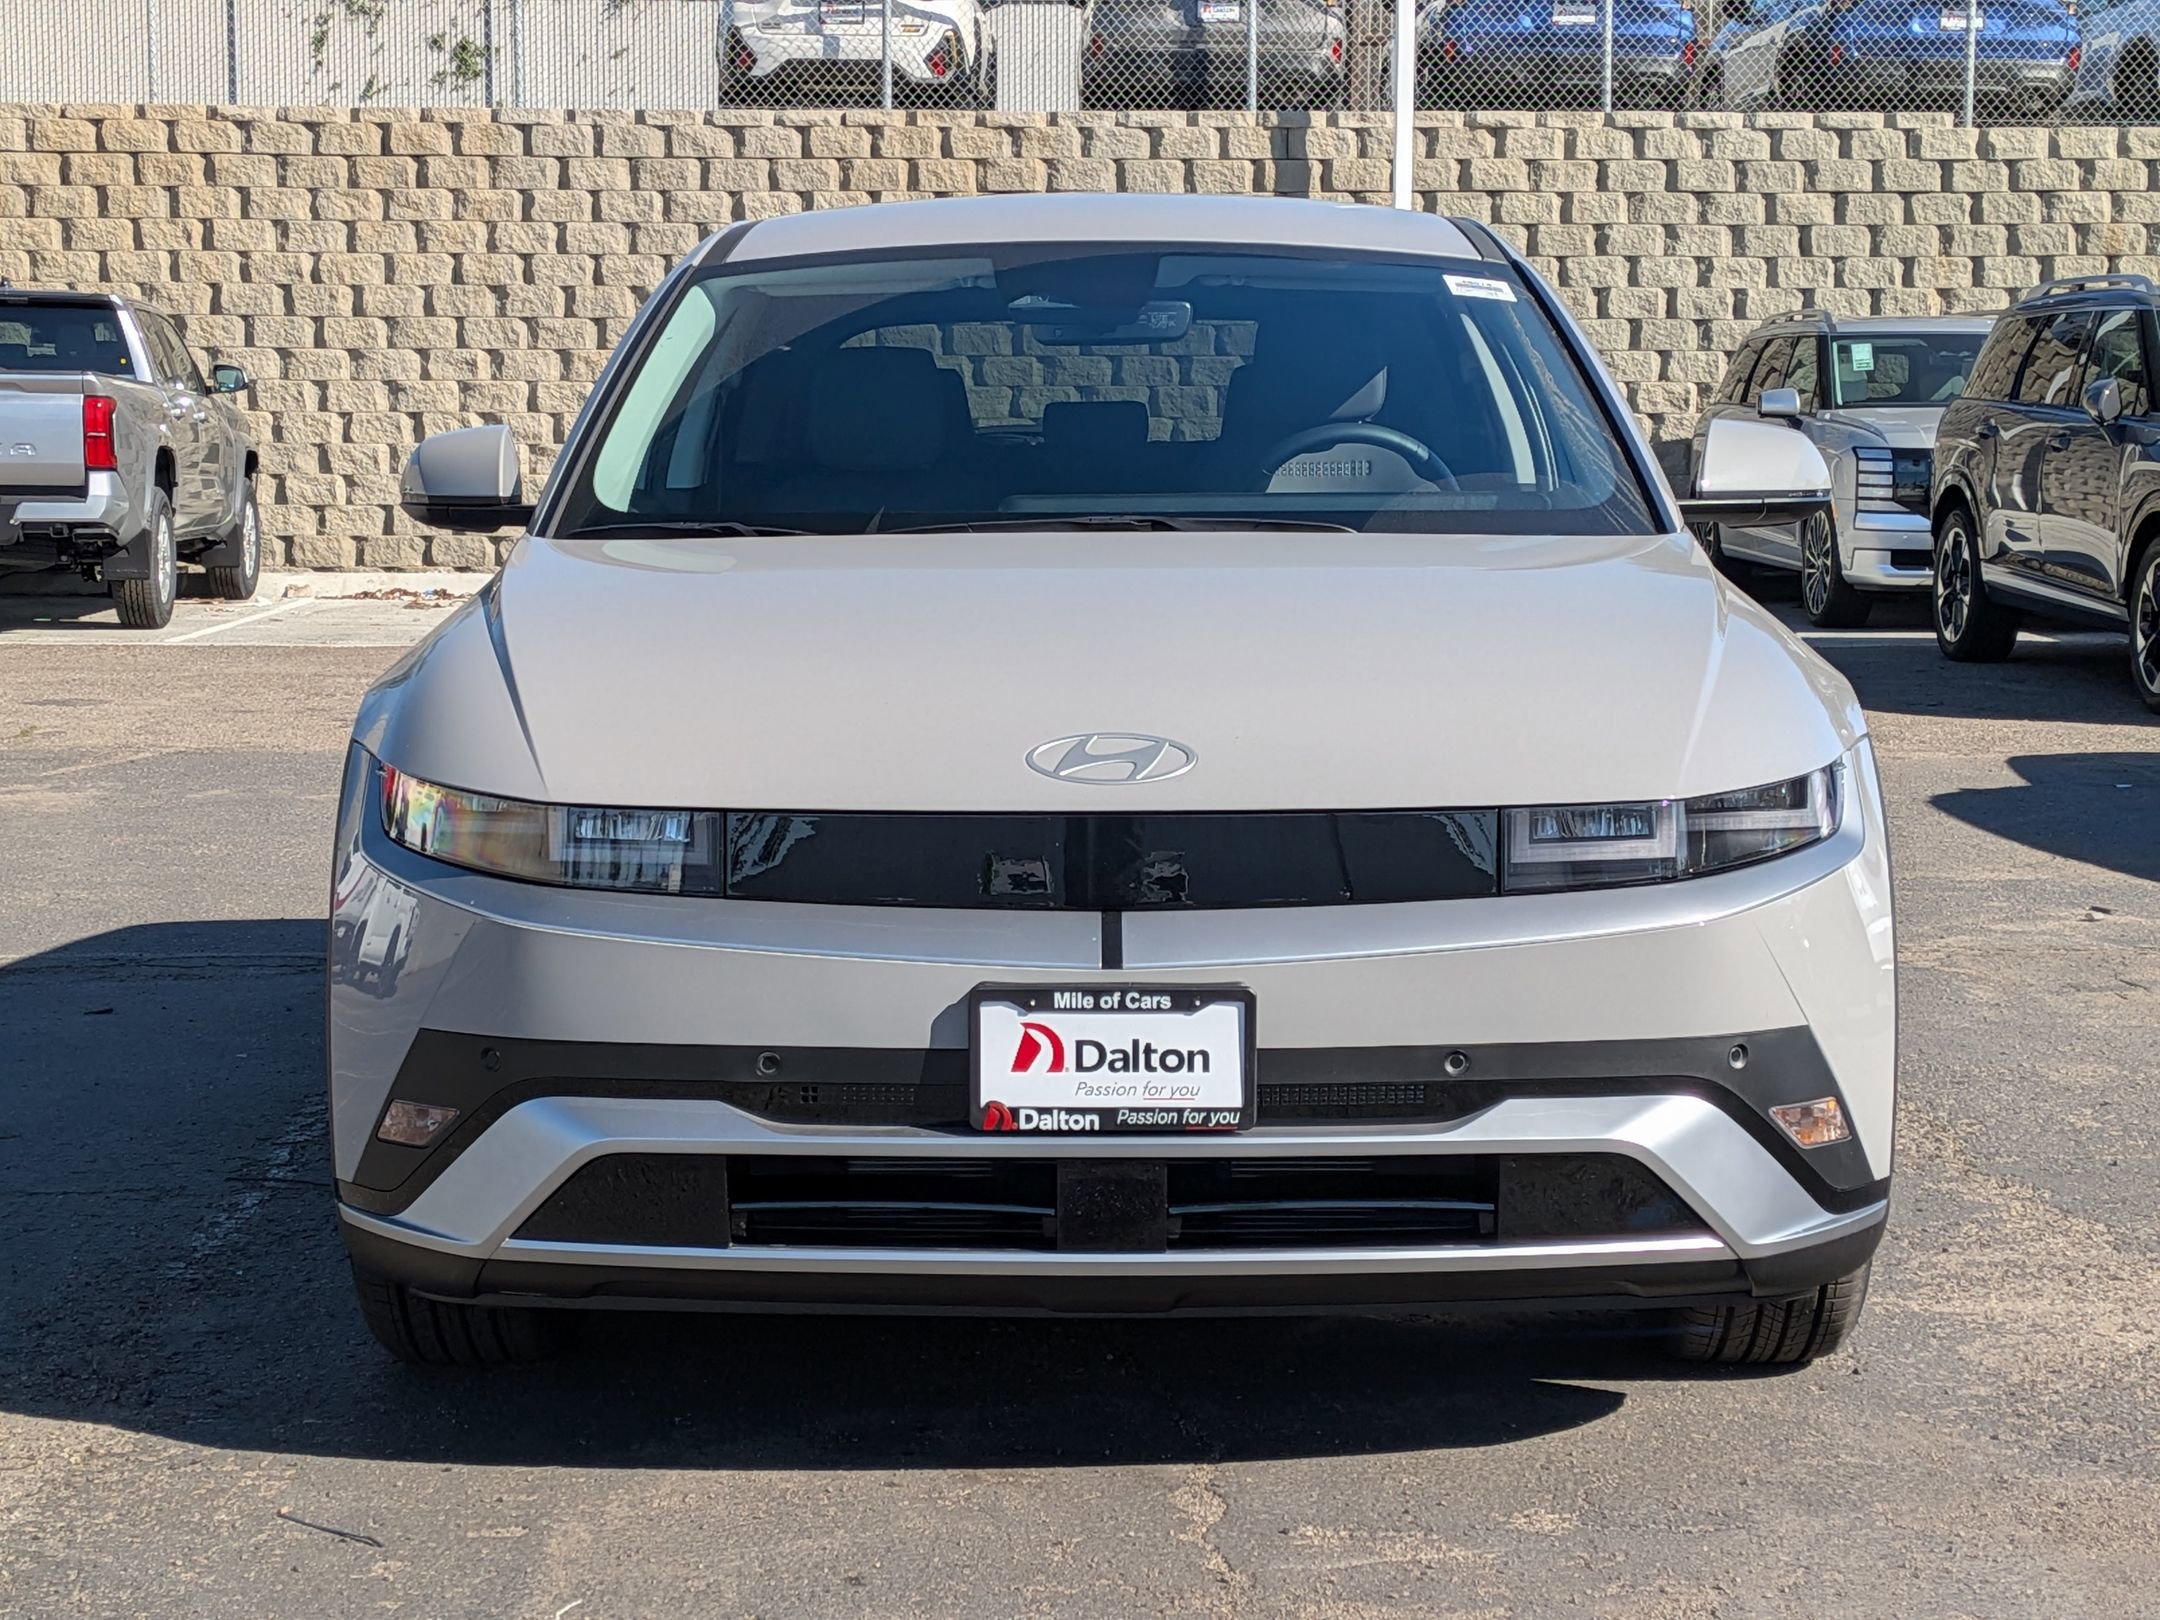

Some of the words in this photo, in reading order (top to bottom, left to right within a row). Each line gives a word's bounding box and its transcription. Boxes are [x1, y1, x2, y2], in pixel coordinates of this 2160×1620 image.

[1054, 991, 1094, 1009] Mile
[1100, 991, 1121, 1009] of
[1125, 991, 1171, 1009] Cars
[1075, 1038, 1210, 1073] Dalton
[1074, 1081, 1137, 1097] Passion
[1141, 1080, 1166, 1097] for
[1168, 1086, 1201, 1099] you
[1019, 1109, 1100, 1131] Dalton
[1116, 1109, 1178, 1125] Passion
[1181, 1108, 1207, 1125] for
[1208, 1110, 1240, 1127] you
